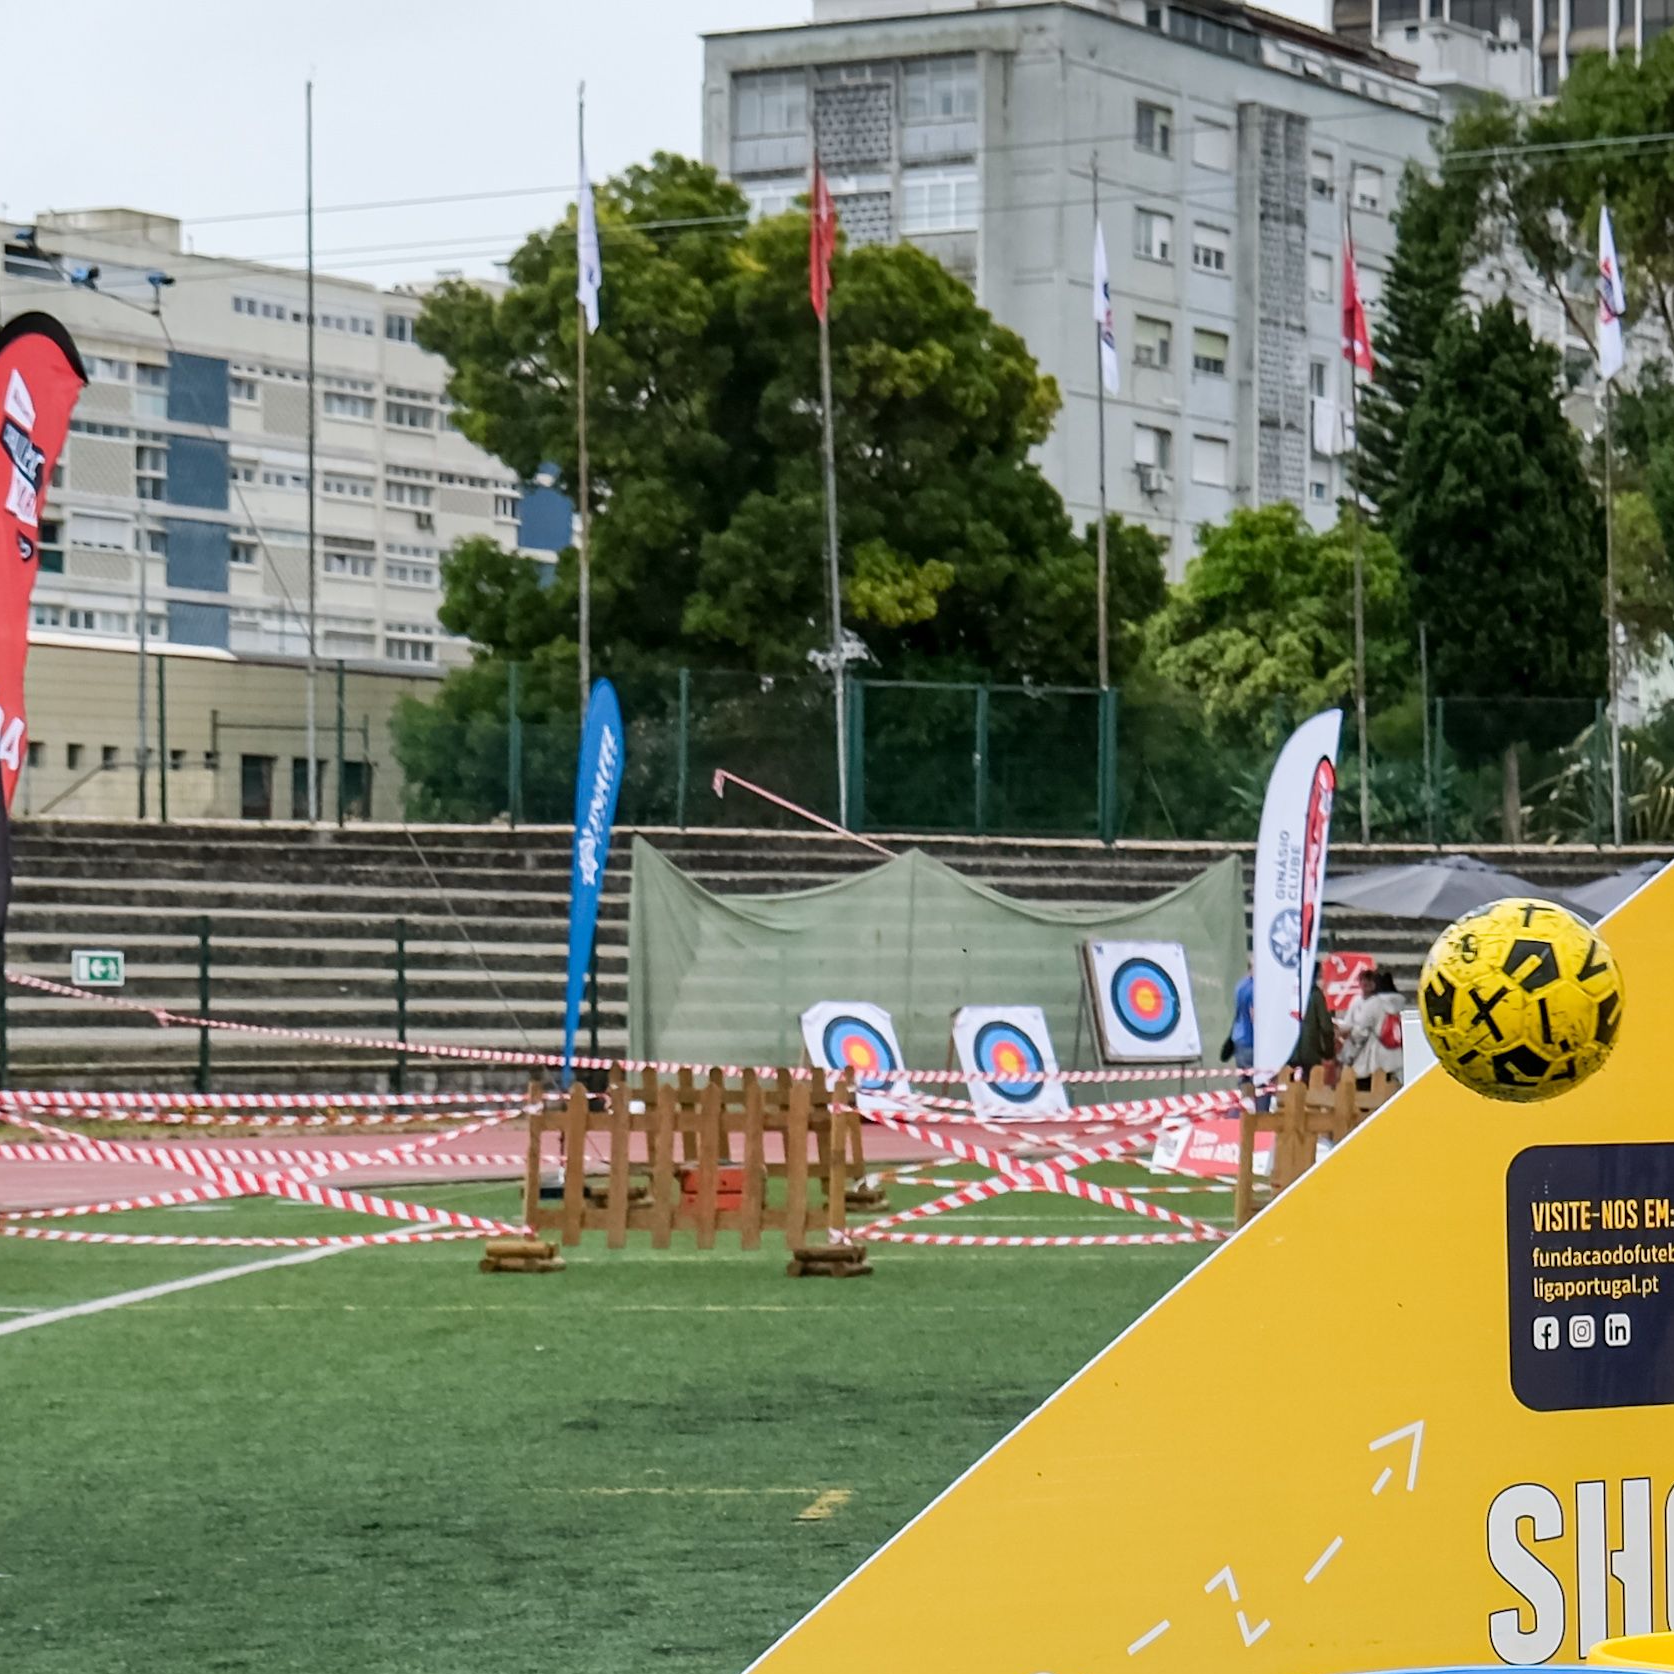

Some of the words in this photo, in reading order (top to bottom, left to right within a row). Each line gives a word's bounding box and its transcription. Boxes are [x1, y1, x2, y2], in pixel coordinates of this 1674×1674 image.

[1275, 830, 1291, 900] GINÁSIO
[1288, 845, 1302, 902] CLUBE
[1531, 1199, 1639, 1232] VISITE-NOS
[1533, 1274, 1660, 1303] ligaportugal.pt
